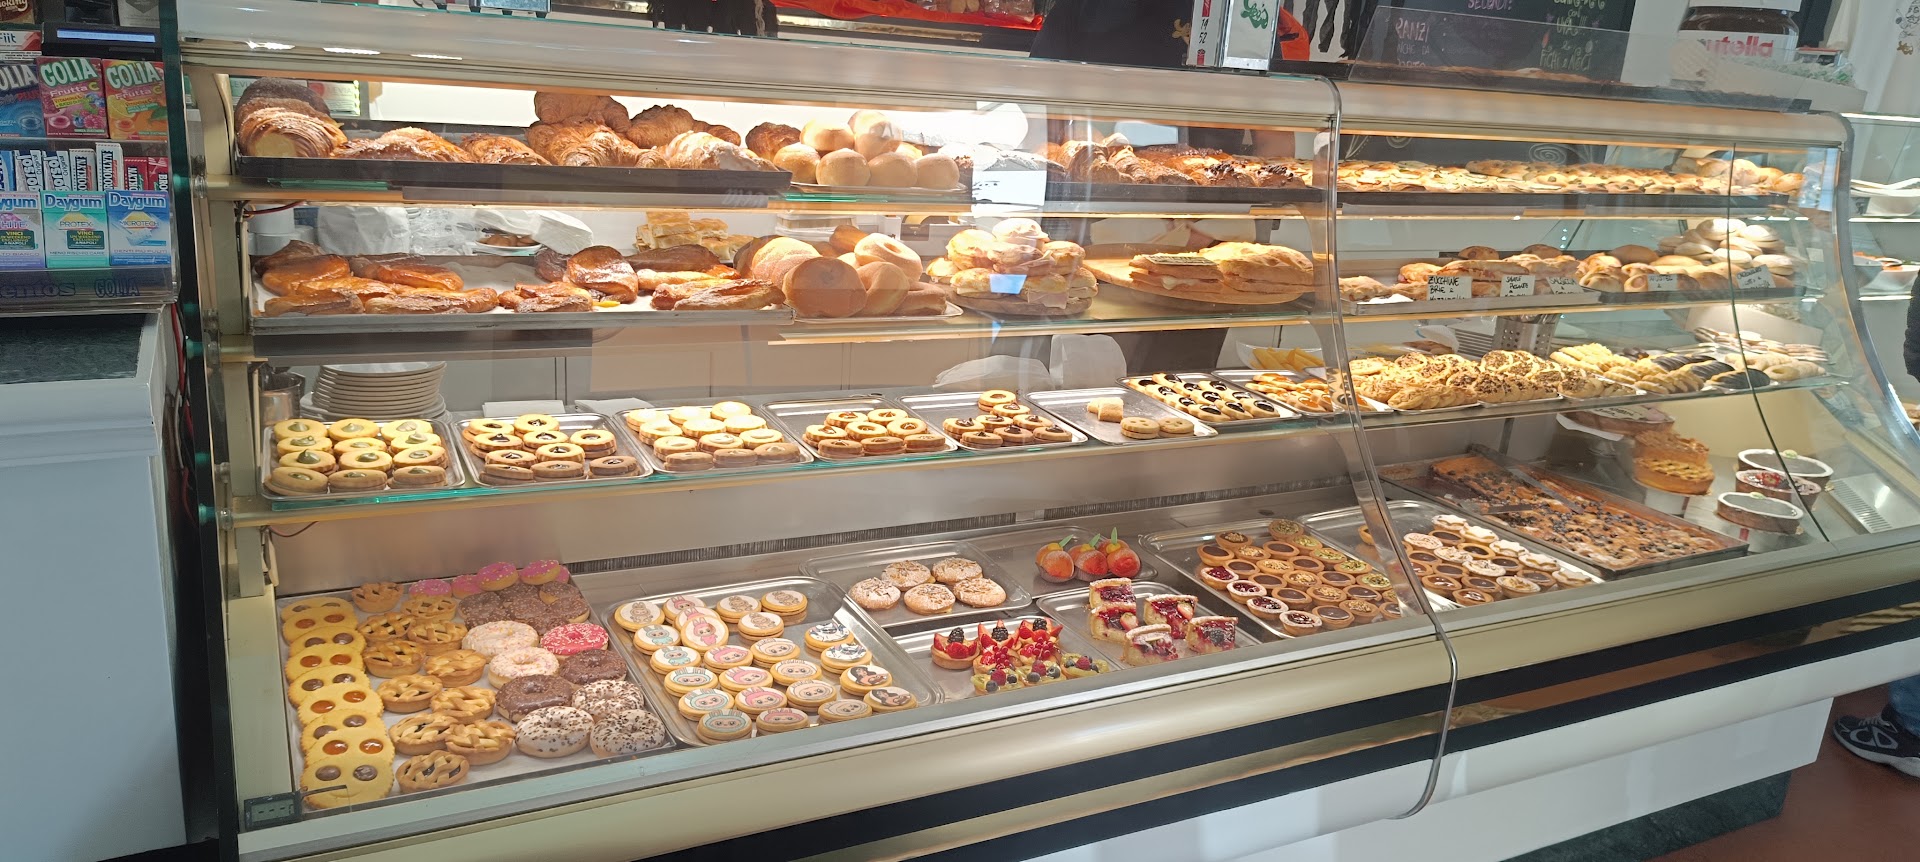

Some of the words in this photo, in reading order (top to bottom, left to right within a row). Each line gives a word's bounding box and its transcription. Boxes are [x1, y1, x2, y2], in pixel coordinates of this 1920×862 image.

[50, 86, 88, 98] Frutta
[115, 88, 151, 100] Frutta
[158, 174, 168, 191] BRO
[45, 194, 104, 211] Daygum
[109, 193, 166, 209] Daygum
[1430, 285, 1446, 294] BRIE
